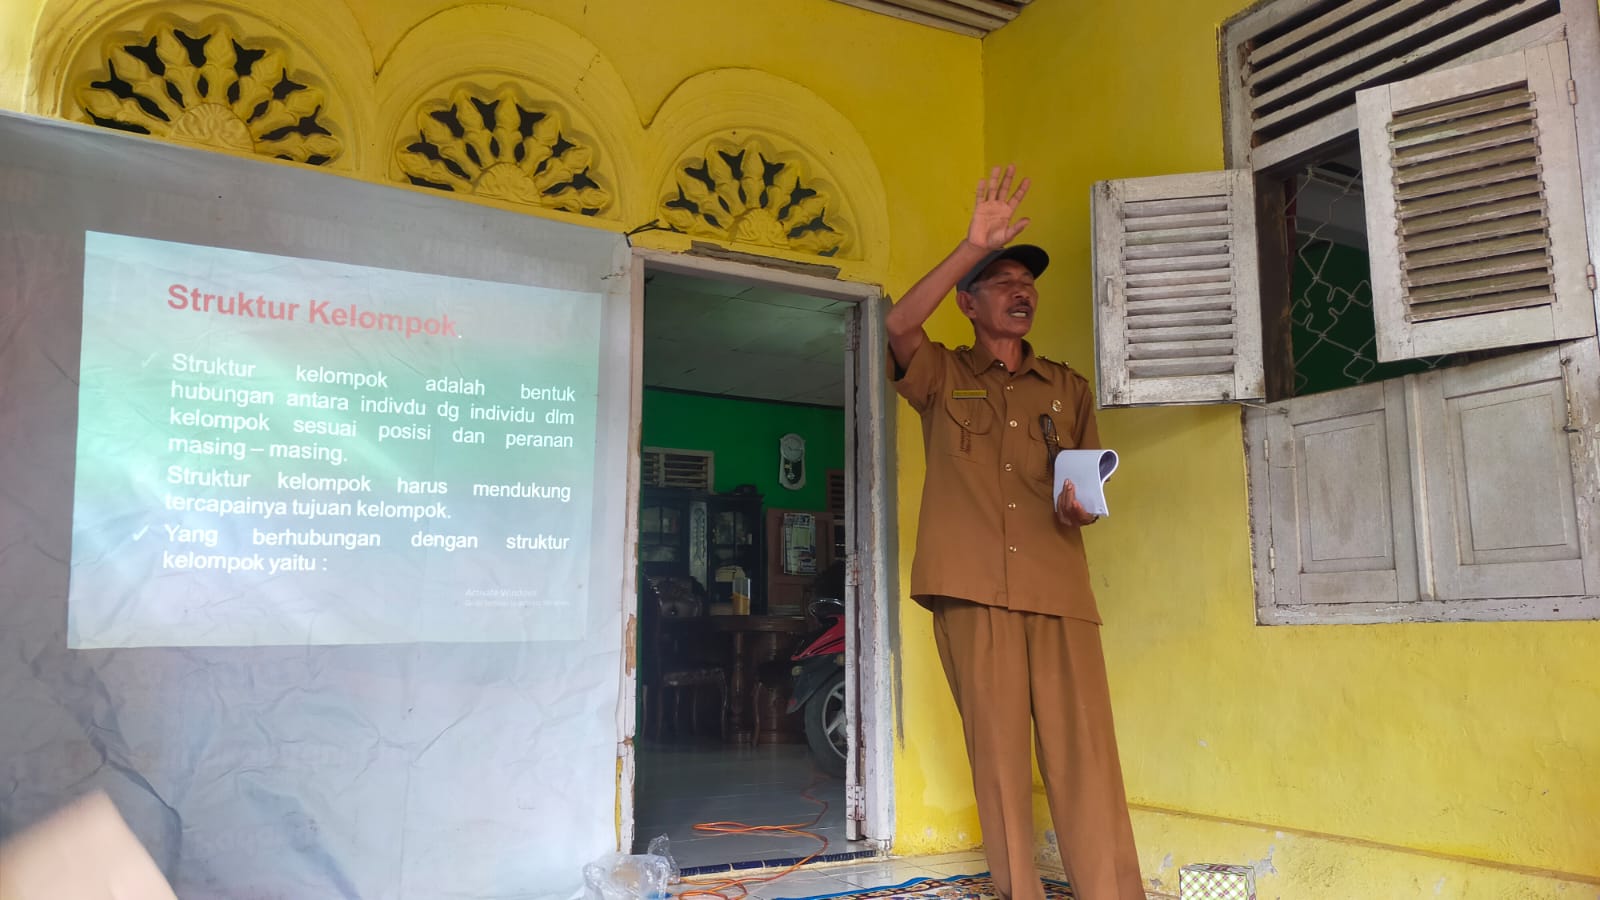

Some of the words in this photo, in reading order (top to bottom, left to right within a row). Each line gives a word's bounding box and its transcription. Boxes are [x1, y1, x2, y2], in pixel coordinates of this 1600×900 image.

[168, 285, 299, 320] Struktur
[172, 353, 256, 377] Struktur
[297, 365, 388, 390] kelompok
[426, 377, 485, 395] adalah
[521, 384, 575, 401] bentuk
[171, 380, 273, 407] hubungan
[287, 392, 348, 410] antara
[361, 397, 425, 415] indivdu
[437, 401, 459, 422] dg
[471, 405, 534, 422] individu
[546, 409, 574, 424] dlm
[170, 407, 270, 433] kelompok
[293, 420, 356, 436] sesuai
[379, 424, 431, 441] posisi
[453, 427, 484, 443] dan
[506, 434, 573, 449] peranan
[169, 437, 246, 460] masing
[270, 443, 347, 465] masing.
[168, 466, 251, 487] Struktur
[278, 472, 371, 494] kelompok
[398, 477, 447, 494] harus
[474, 482, 570, 502] mendukung
[165, 497, 287, 518] tercapainya
[293, 499, 351, 519] tujuan
[357, 500, 451, 522] kelompok.
[164, 524, 218, 547] Yang
[253, 528, 380, 550] berhubungan
[411, 531, 478, 551] dengan
[507, 534, 570, 549] struktur
[163, 550, 264, 573] kelompok
[269, 554, 316, 573] yaitu
